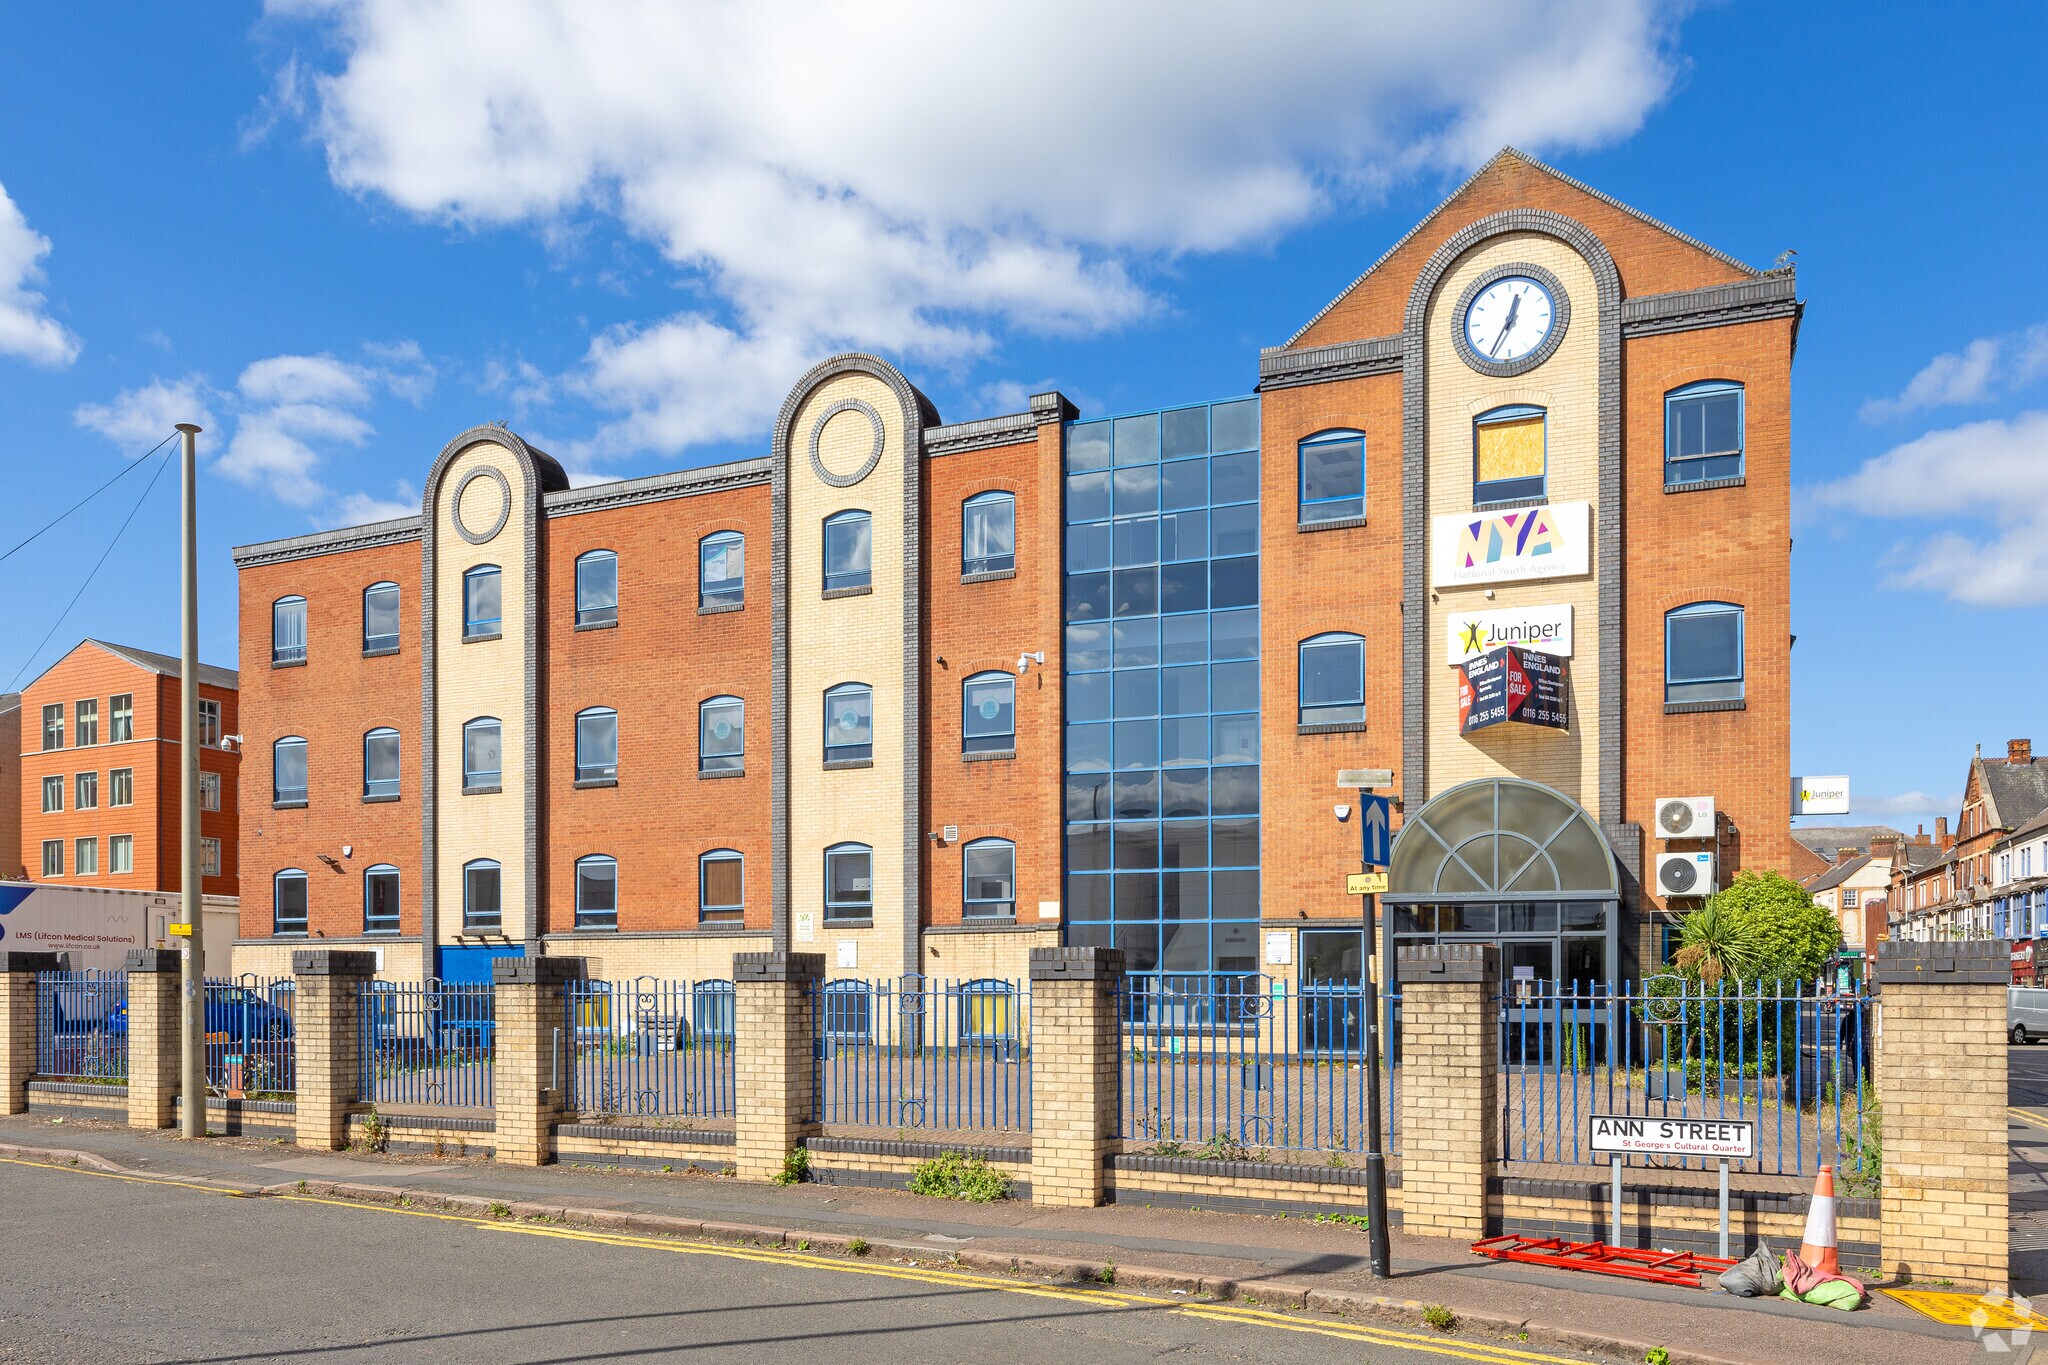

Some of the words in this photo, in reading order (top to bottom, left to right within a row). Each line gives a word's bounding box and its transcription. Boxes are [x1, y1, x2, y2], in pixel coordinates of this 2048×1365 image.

[1455, 508, 1565, 568] NYA
[1453, 568, 1496, 580] National
[1498, 566, 1527, 576] Youth
[1529, 563, 1567, 574] Agency
[1487, 621, 1562, 644] Juniper
[1468, 657, 1488, 671] INNES
[1523, 652, 1547, 664] INNES
[1468, 660, 1499, 679] ENGLAND
[1523, 661, 1561, 675] ENGLAND
[1509, 671, 1522, 683] FOR
[1509, 682, 1527, 696] SALE
[1460, 694, 1471, 709] SALE
[1479, 710, 1490, 723] 255
[1490, 705, 1505, 719] 5455
[1522, 707, 1536, 719] 0116
[1538, 709, 1550, 721] 255
[1551, 712, 1567, 724] 5455
[1810, 789, 1844, 799] Juniper
[15, 931, 32, 939] LMS
[34, 931, 62, 941] (Lifcon
[64, 933, 95, 942] Medical
[97, 934, 136, 944] Solutions)
[48, 942, 101, 950] www.lifcon.co.uk
[1596, 1119, 1644, 1137] ANN
[1659, 1122, 1746, 1142] STREET
[1622, 1139, 1631, 1147] St
[1674, 1142, 1709, 1151] Cultural
[1712, 1143, 1746, 1153] Quarter
